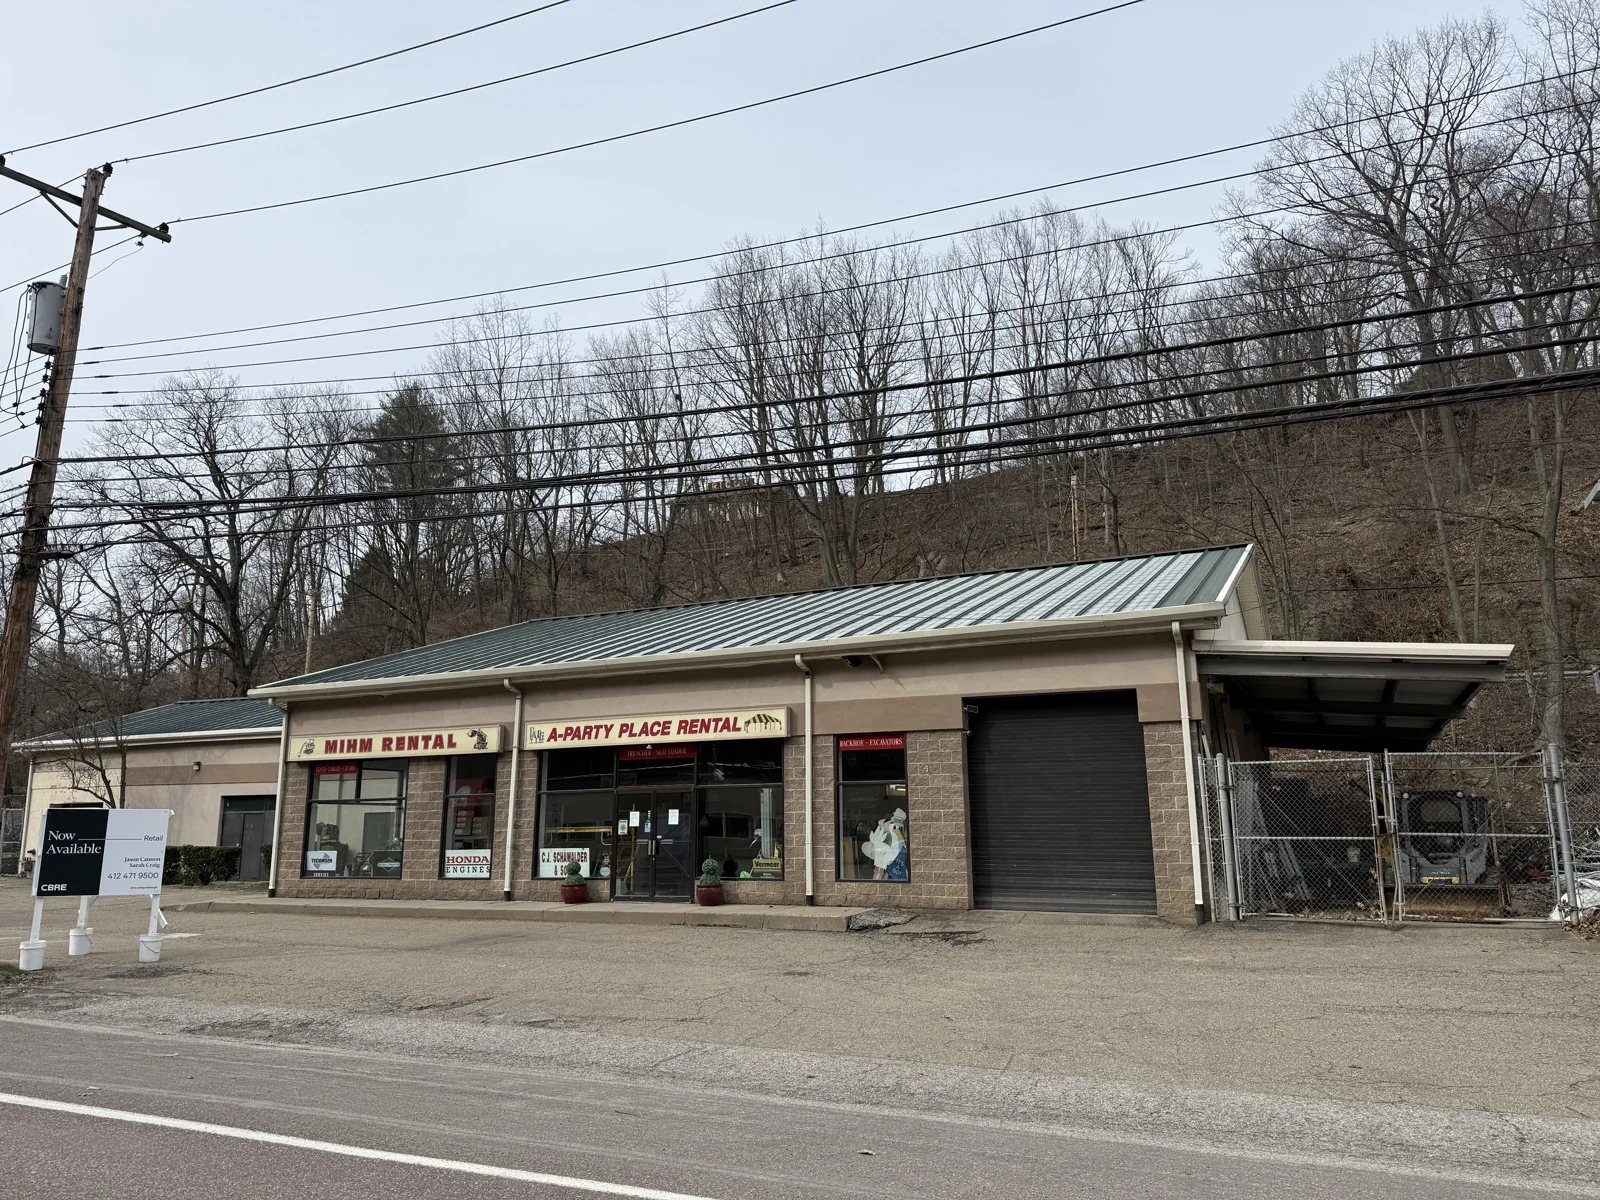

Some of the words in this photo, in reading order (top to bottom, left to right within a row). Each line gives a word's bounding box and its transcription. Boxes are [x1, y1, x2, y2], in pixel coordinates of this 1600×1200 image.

[546, 723, 615, 742] A-PARTY
[617, 720, 672, 739] PLACE
[677, 716, 742, 736] RENTAL
[324, 737, 373, 755] MIHM
[381, 733, 457, 752] RENTAL
[839, 739, 865, 748] BACKHOE
[869, 737, 903, 747] EXCAVATORS
[627, 749, 652, 757] TRENCHER
[667, 747, 687, 755] LOADER
[48, 830, 76, 841] Now
[143, 834, 164, 842] Retail
[46, 843, 102, 855] Available
[446, 855, 490, 864] HONDA
[754, 860, 780, 868] Vermeer
[446, 865, 490, 874] ENGINES
[554, 864, 558, 876] &
[107, 872, 121, 880] 412
[138, 871, 159, 879] 9500
[40, 883, 68, 892] CBRE
